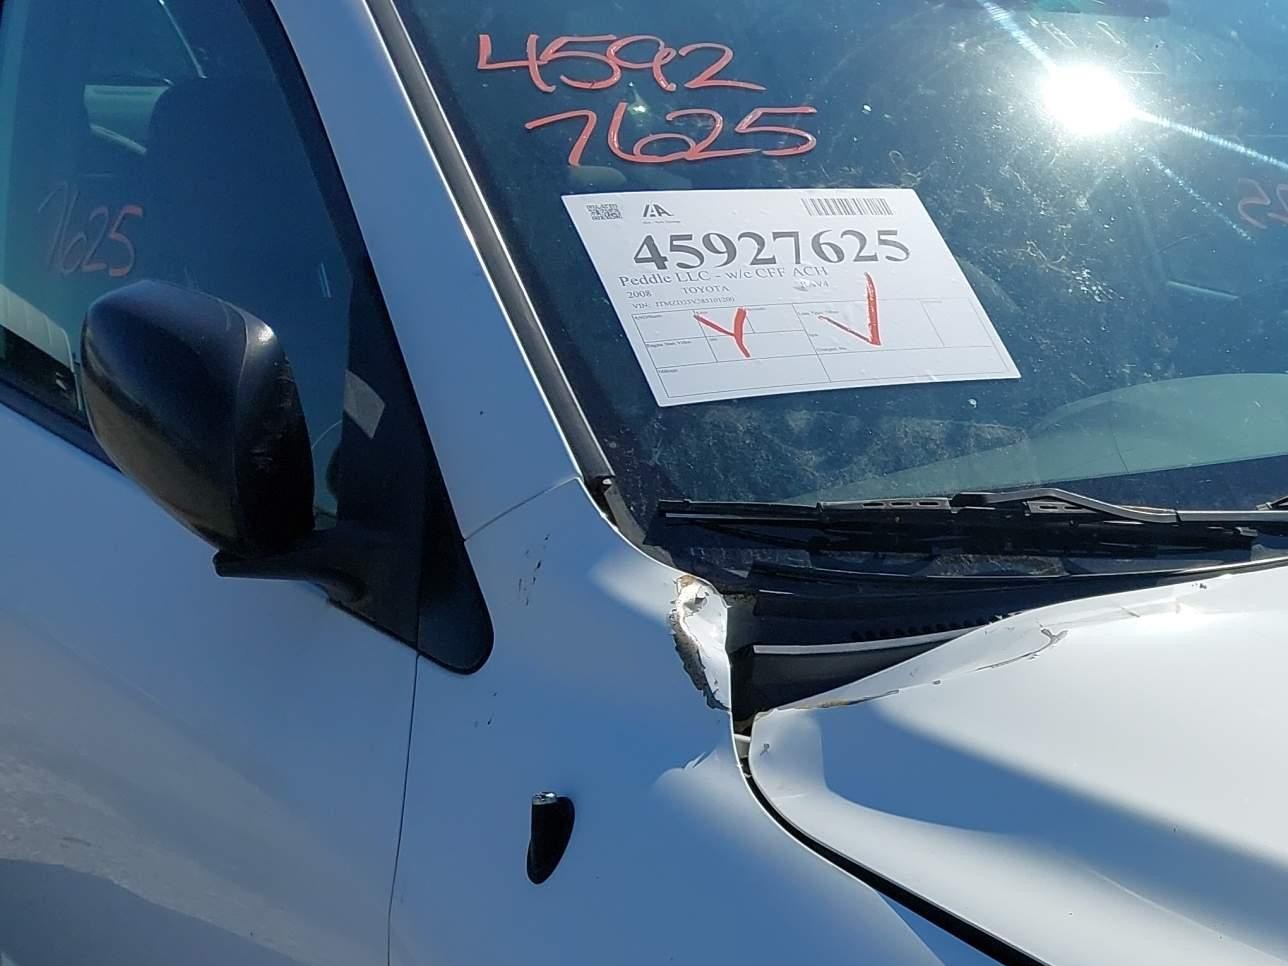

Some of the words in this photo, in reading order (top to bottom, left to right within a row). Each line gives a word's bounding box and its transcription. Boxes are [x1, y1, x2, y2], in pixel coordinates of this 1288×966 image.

[477, 34, 768, 92] 4592
[524, 102, 818, 167] 7625
[38, 180, 143, 277] 7625
[633, 228, 911, 271] 45927625
[619, 273, 672, 287] Peddle
[677, 269, 711, 283] LLC
[793, 266, 829, 277] ACH
[626, 289, 653, 299] 2008
[682, 285, 730, 295] TOYOTA
